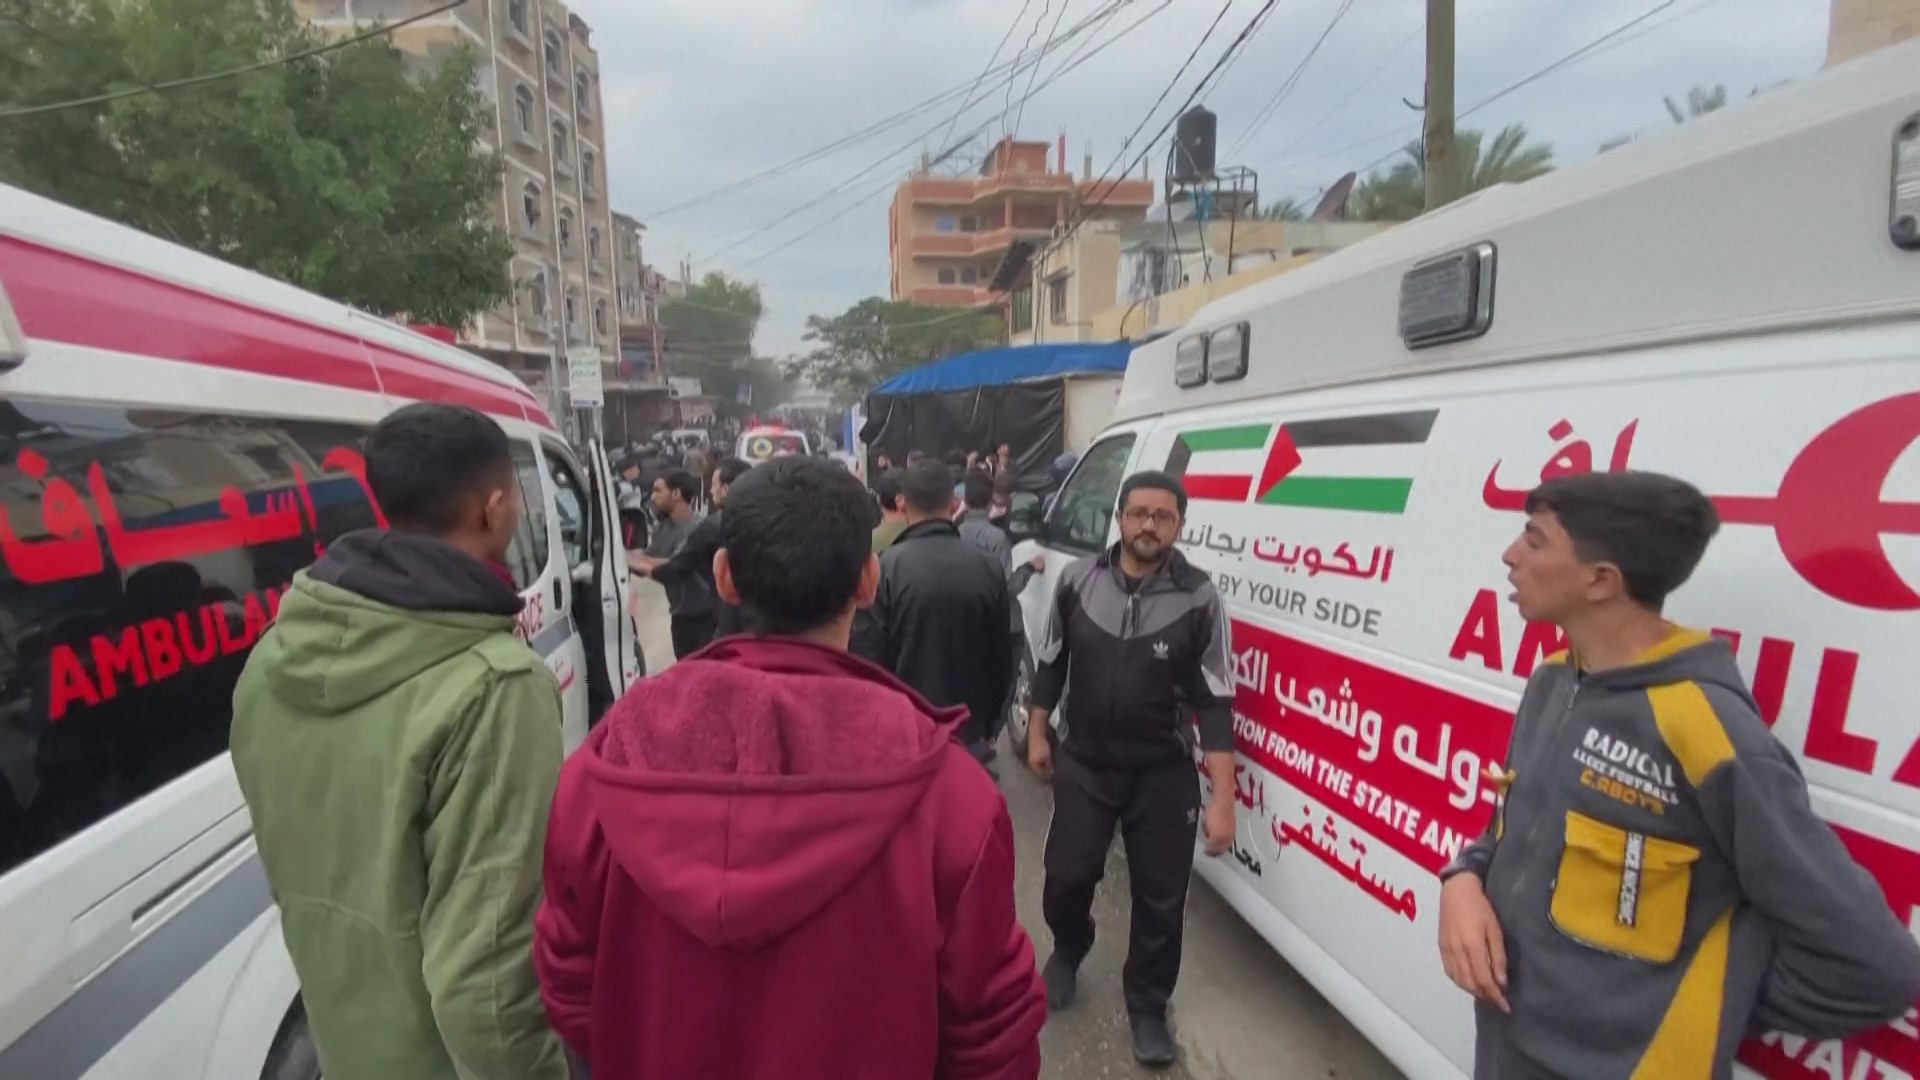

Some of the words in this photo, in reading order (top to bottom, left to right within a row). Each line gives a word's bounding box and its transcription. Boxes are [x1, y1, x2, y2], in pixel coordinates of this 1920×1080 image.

[1177, 524, 1248, 562] بجانب
[1252, 535, 1395, 583] الكويت
[1219, 573, 1243, 597] BY
[1249, 579, 1306, 617] YOUR
[1314, 597, 1381, 637] SIDE
[48, 582, 293, 722] AMBULA
[1274, 671, 1383, 762] وشعب
[1231, 710, 1267, 748] TION
[1265, 729, 1315, 778] FROM
[1317, 758, 1353, 799] THE
[1353, 780, 1421, 840] STATE
[1583, 727, 1676, 787] RADICAL
